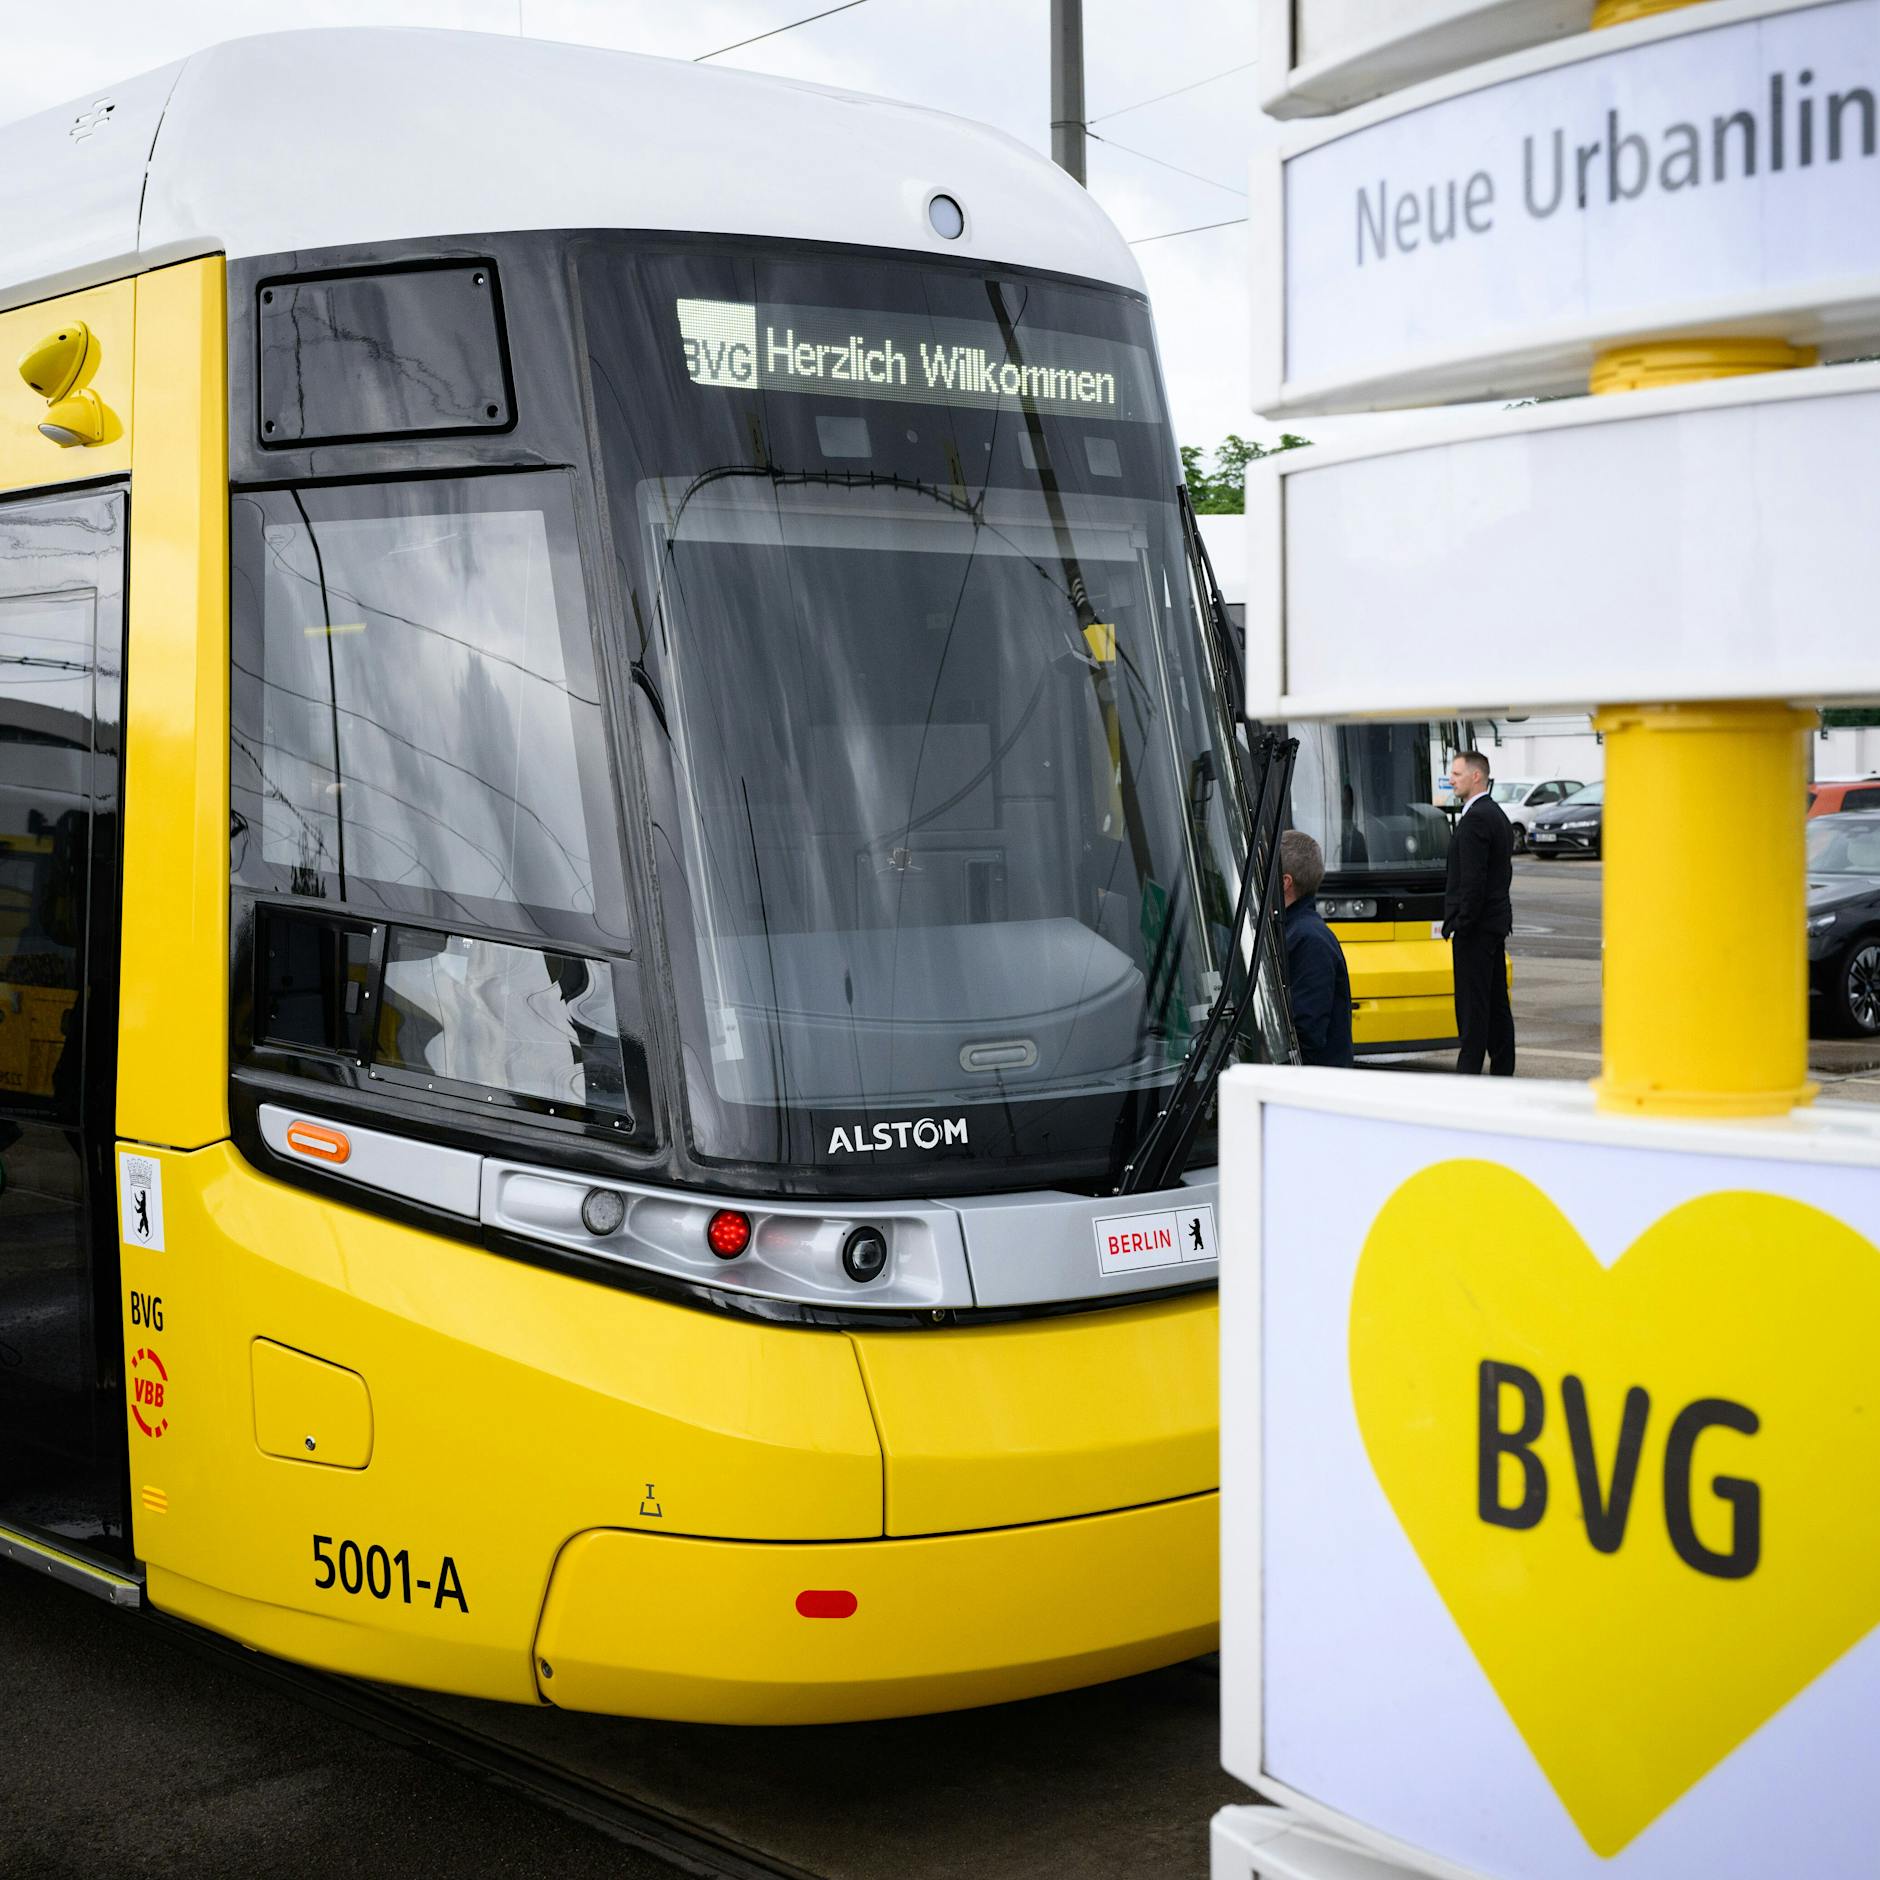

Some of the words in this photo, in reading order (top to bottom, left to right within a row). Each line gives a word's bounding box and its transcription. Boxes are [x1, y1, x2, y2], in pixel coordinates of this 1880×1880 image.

[1356, 169, 1495, 267] Neue
[1522, 69, 1876, 220] Urbanlin
[767, 327, 907, 384] Herzlich
[921, 343, 1115, 404] Willkommen
[828, 1117, 968, 1154] ALSTOM
[1108, 1229, 1172, 1255] BERLIN
[130, 1290, 164, 1331] BVG
[134, 1377, 165, 1408] VBB
[1478, 1359, 1761, 1580] BVG
[313, 1534, 469, 1613] 5001-A
